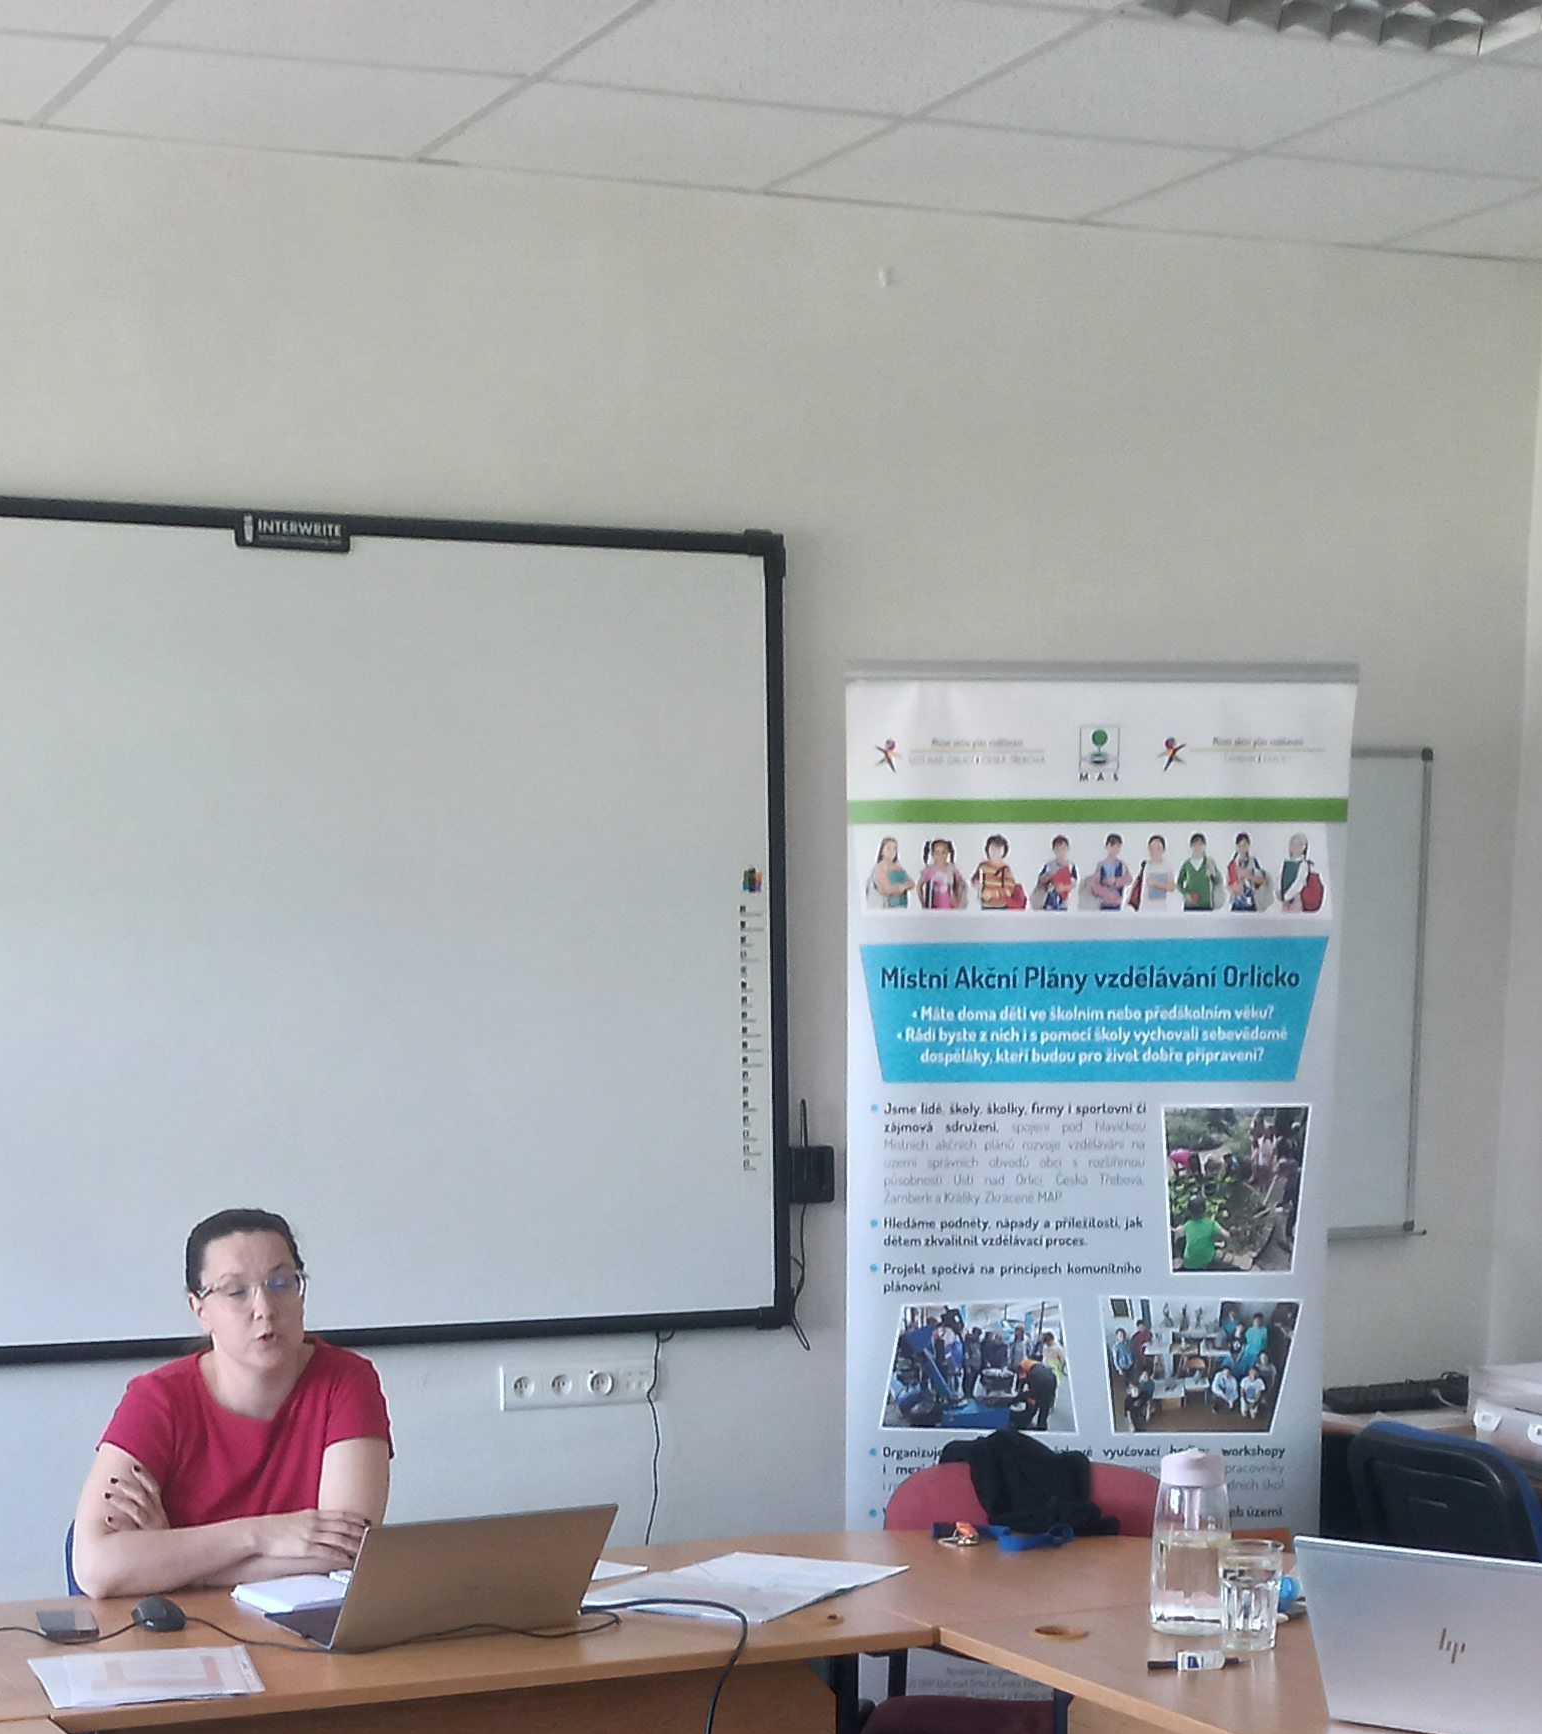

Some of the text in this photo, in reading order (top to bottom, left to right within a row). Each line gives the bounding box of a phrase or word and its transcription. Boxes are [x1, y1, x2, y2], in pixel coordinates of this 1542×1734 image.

[259, 518, 343, 537] INTERWRITE
[881, 964, 1300, 995] Místní Akční Plány vzdělávání Orlicko
[920, 1004, 1274, 1023] Máte doma děti ve školním nebo předškolním věku?
[905, 1027, 936, 1042] Rádi
[939, 1027, 978, 1046] byste
[979, 1031, 987, 1042] z
[990, 1027, 1020, 1042] nich
[1030, 1030, 1038, 1042] s
[1040, 1026, 1092, 1045] pomocí
[1094, 1025, 1131, 1045] školy
[1133, 1025, 1199, 1045] vychovali
[1202, 1024, 1288, 1041] sebevědomé
[920, 1047, 1265, 1067] dospěláky, kteří budou pro život dobře připraveni?
[884, 1102, 917, 1115] Jsme
[949, 1102, 983, 1118] školy,
[987, 1102, 1027, 1118] školky,
[1031, 1101, 1064, 1118] firmy
[1075, 1102, 1132, 1118] sportovní
[884, 1121, 933, 1136] zájmová
[1062, 1120, 1083, 1136] pod
[1132, 1141, 1145, 1150] na
[984, 1173, 1005, 1186] nad
[884, 1216, 936, 1229] Hledáme
[996, 1216, 1039, 1232] nápady
[1043, 1220, 1050, 1229] a
[1124, 1215, 1143, 1231] jak
[884, 1235, 921, 1247] dětem
[924, 1234, 978, 1247] zkvalitnit
[981, 1234, 1043, 1247] vzdělávací
[884, 1261, 1142, 1278] Projekt spočívá na principech komunitního
[1103, 1445, 1160, 1459] vyučovací
[1221, 1444, 1285, 1459] workshopy
